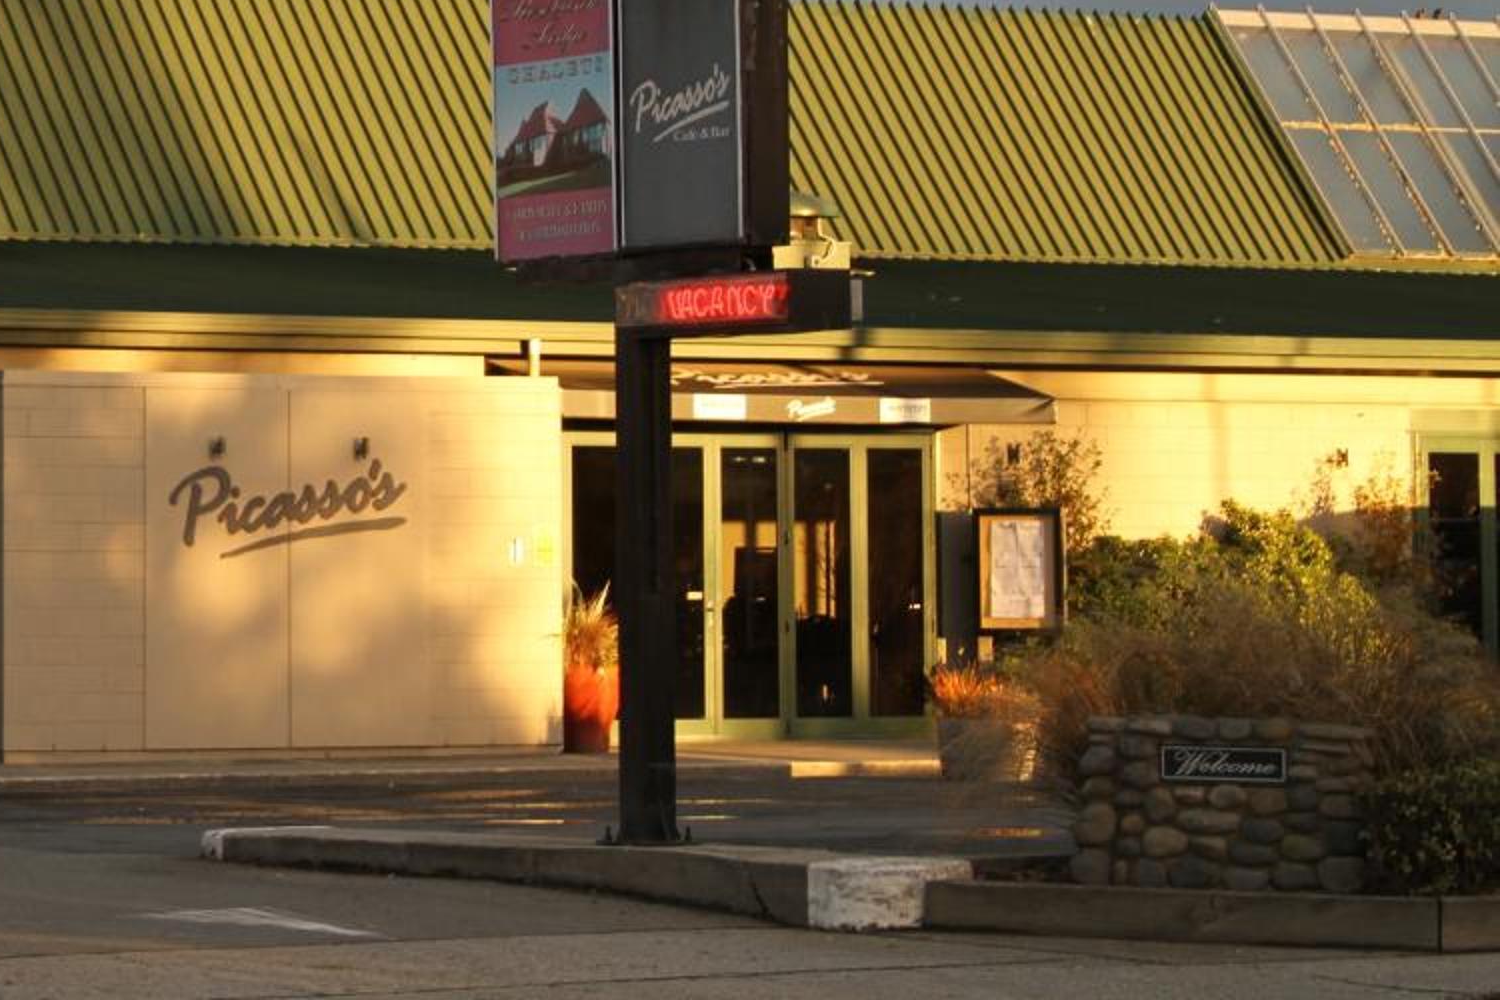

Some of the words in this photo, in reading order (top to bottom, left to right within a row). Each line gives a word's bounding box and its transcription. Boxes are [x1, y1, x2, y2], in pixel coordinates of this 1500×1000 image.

[630, 62, 731, 133] Picasso's
[666, 284, 776, 320] VACANCY
[168, 458, 407, 547] Picasso's
[1174, 749, 1278, 776] Welcome
